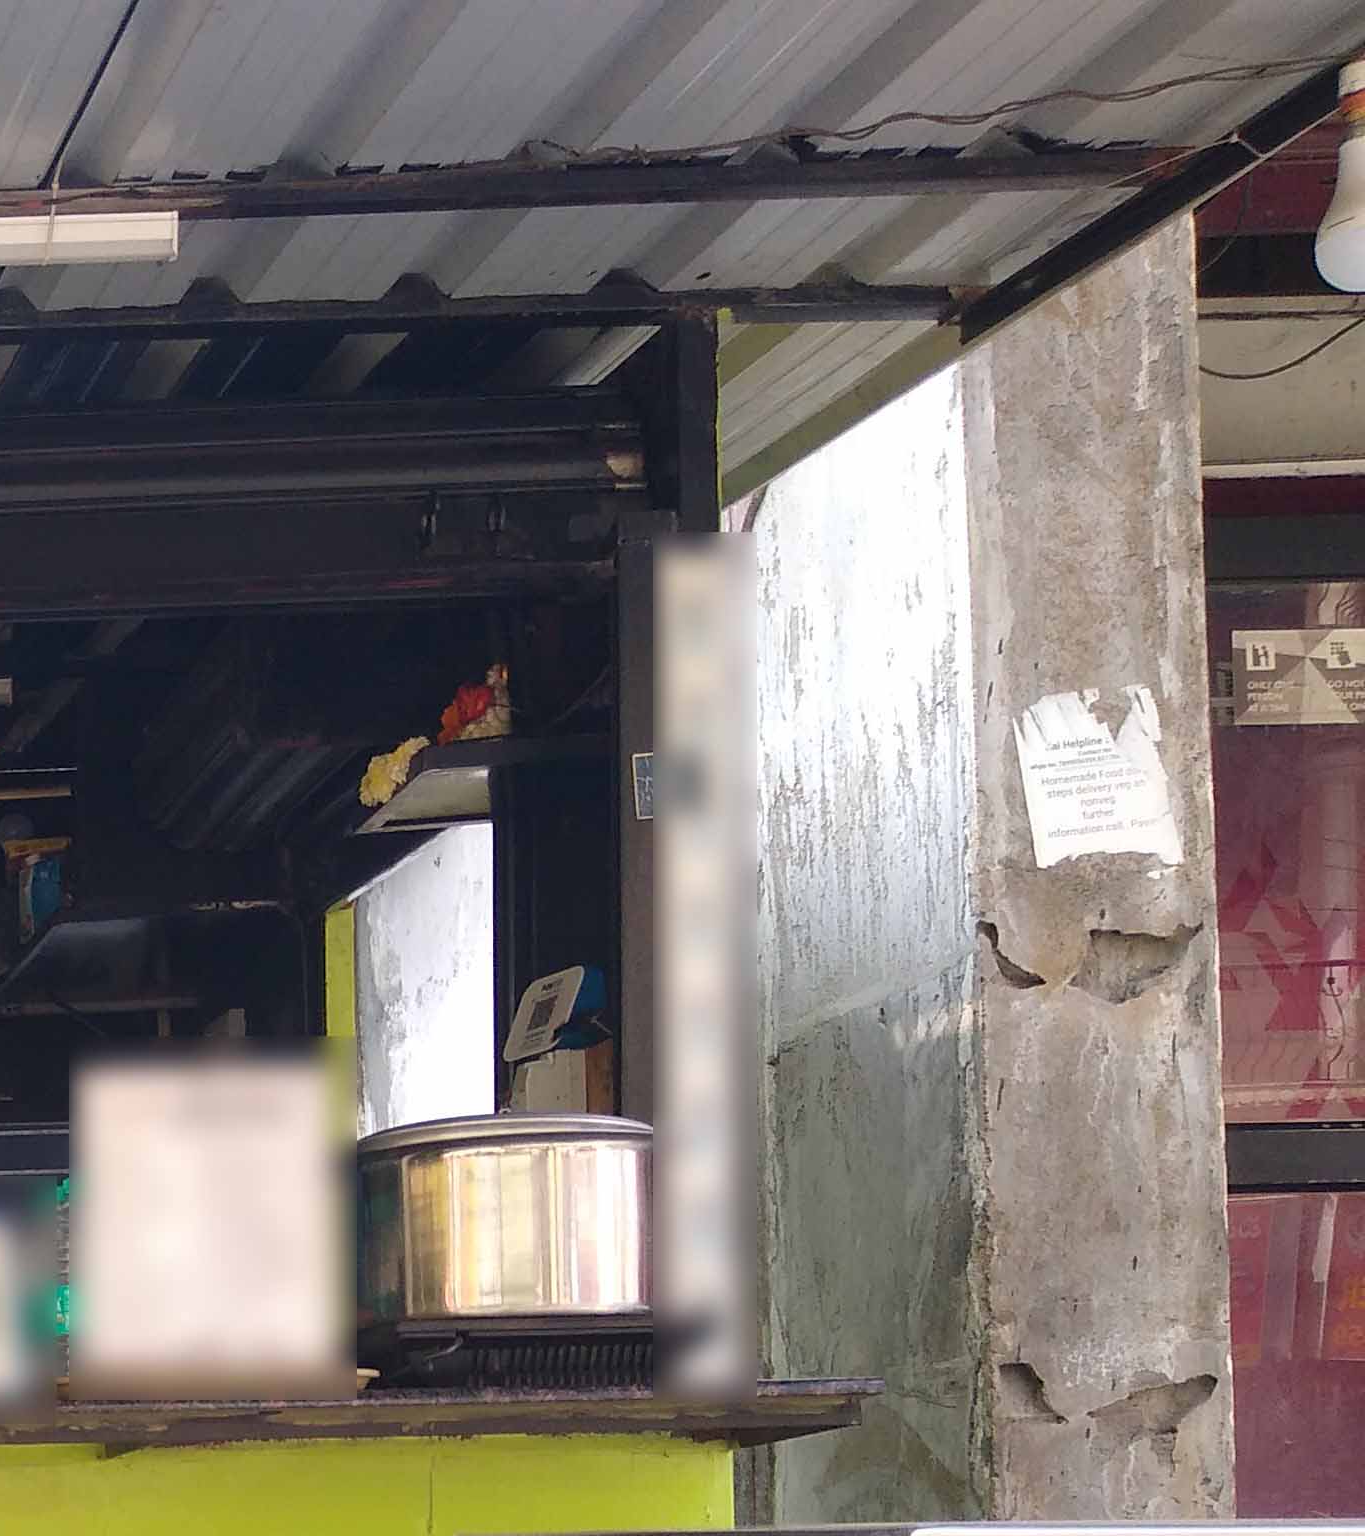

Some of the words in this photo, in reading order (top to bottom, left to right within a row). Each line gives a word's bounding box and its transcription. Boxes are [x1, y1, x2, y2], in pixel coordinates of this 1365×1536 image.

[1063, 737, 1103, 750] Helpline
[1041, 772, 1097, 786] Homemade
[1099, 769, 1124, 780] Food
[1046, 787, 1073, 800] steps
[1075, 781, 1112, 795] delivery
